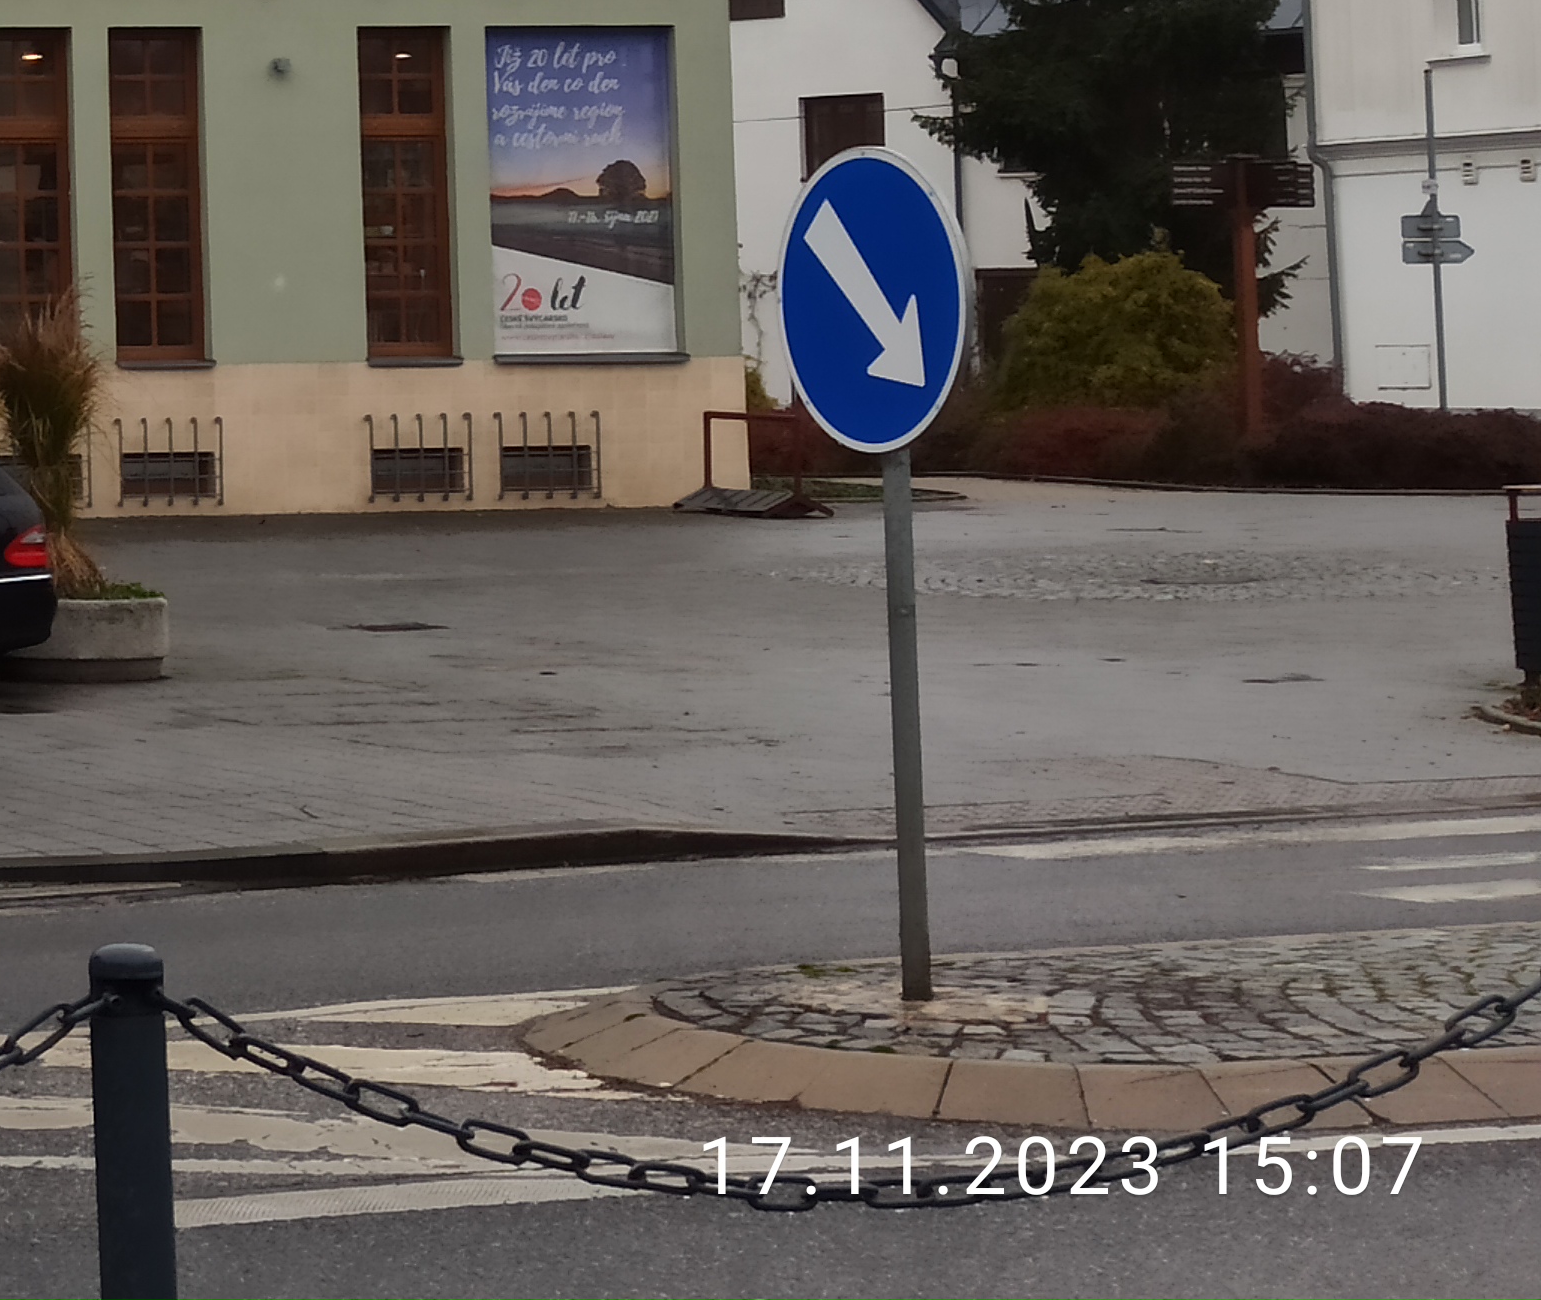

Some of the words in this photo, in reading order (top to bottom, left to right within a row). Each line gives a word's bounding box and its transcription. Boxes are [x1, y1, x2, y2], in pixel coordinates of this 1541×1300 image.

[527, 49, 548, 68] 20
[553, 41, 581, 69] let
[582, 50, 617, 74] pro
[493, 70, 523, 96] Vás
[527, 71, 560, 94] den
[564, 77, 584, 93] co
[588, 71, 620, 94] den
[550, 275, 586, 311] let
